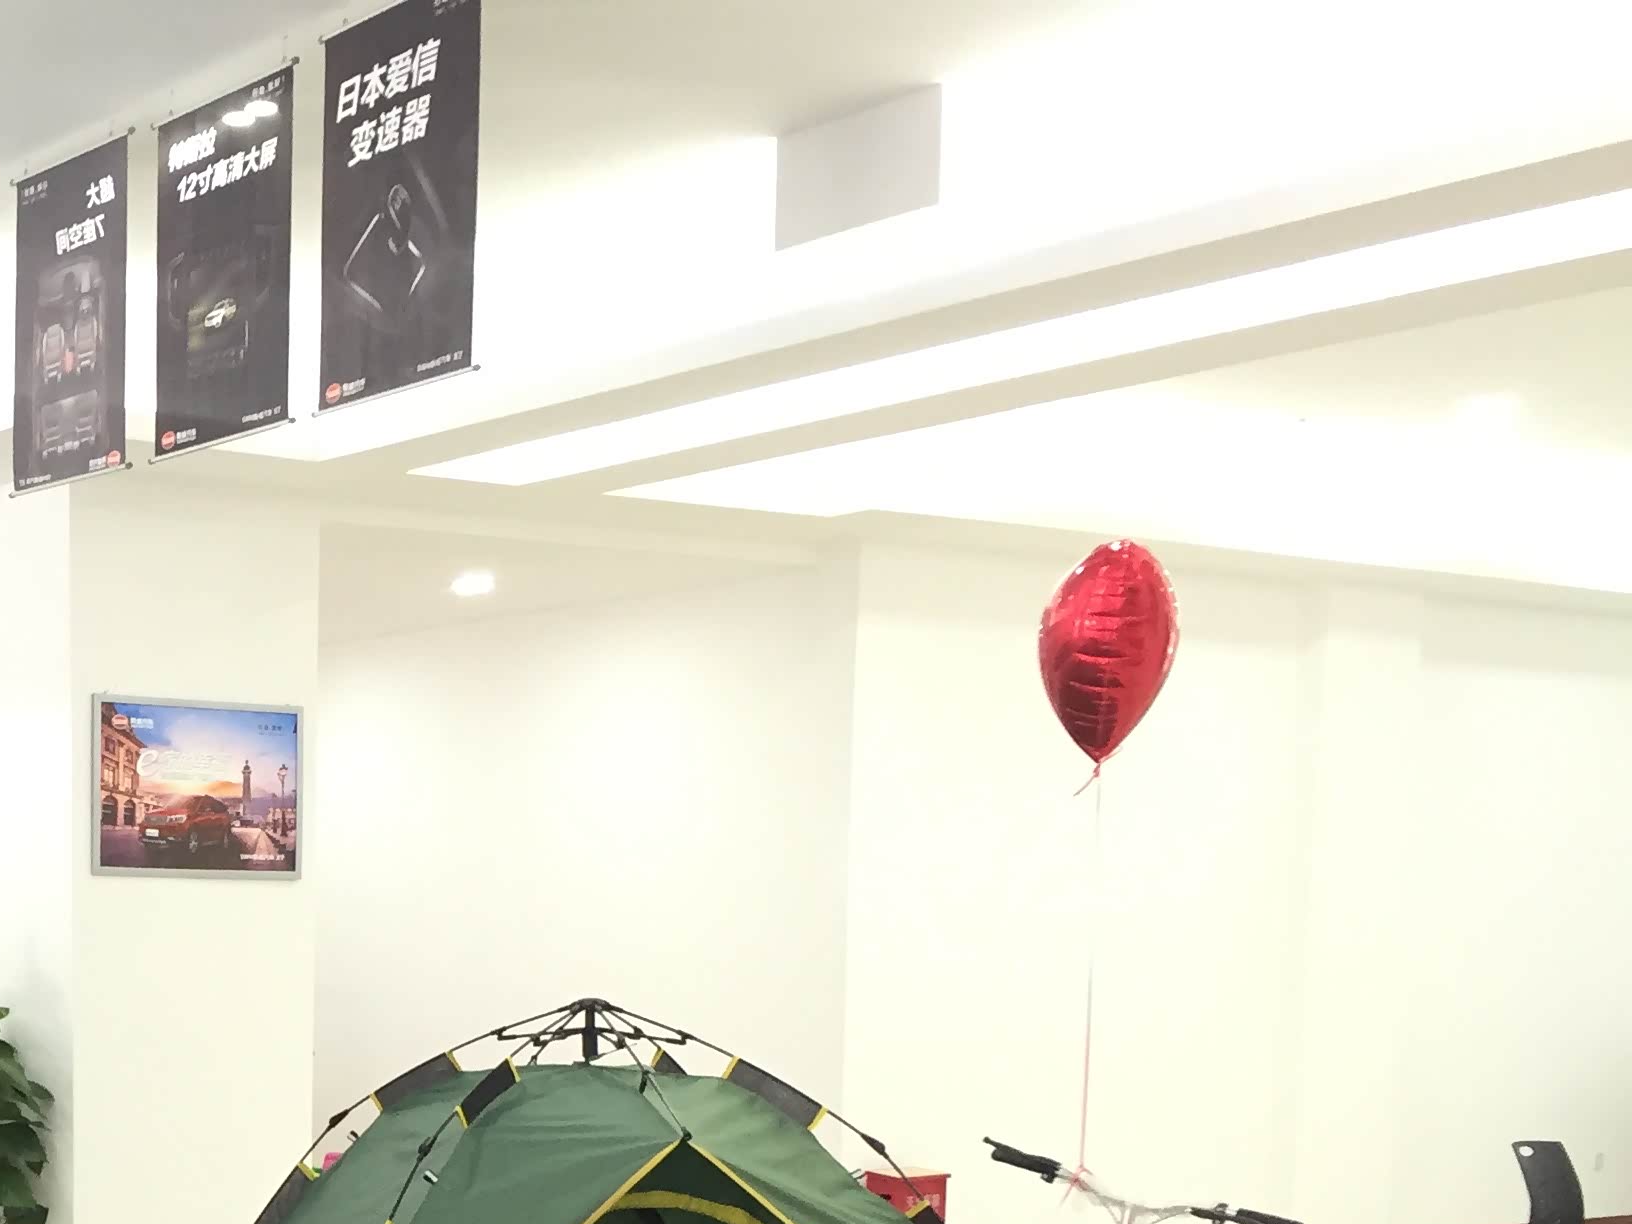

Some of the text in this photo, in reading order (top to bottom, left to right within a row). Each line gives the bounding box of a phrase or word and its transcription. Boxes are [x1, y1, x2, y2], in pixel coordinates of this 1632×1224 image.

[336, 38, 441, 123] 日本爱信
[348, 94, 431, 168] 变速器
[177, 136, 278, 202] 12寸高清大屏
